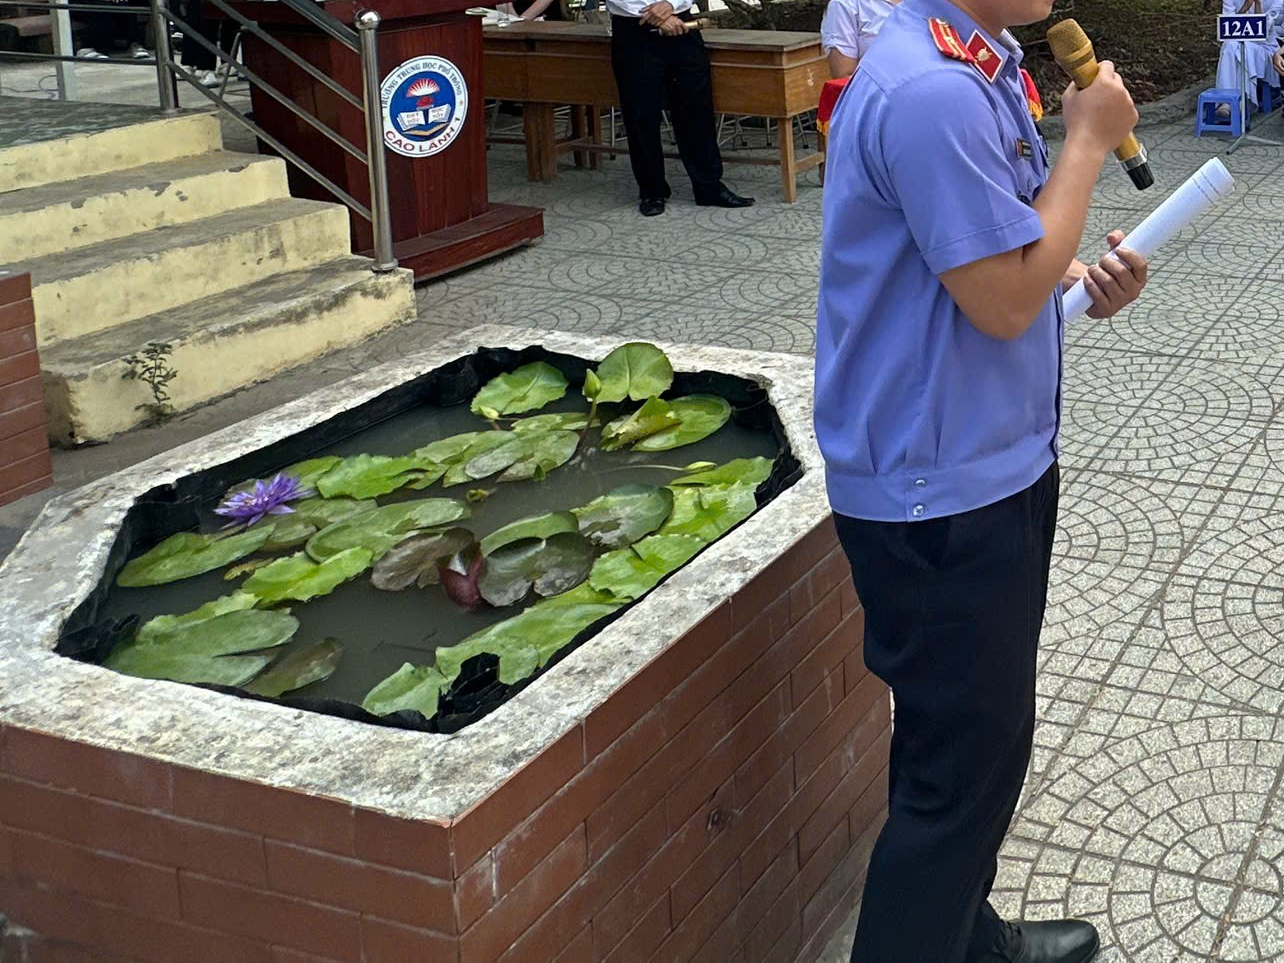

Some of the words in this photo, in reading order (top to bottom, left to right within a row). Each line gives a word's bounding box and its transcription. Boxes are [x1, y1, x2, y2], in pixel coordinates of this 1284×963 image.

[1222, 20, 1264, 37] 12A1
[397, 63, 421, 80] TRUNG
[422, 62, 437, 70] HỌC
[385, 130, 415, 151] CAO
